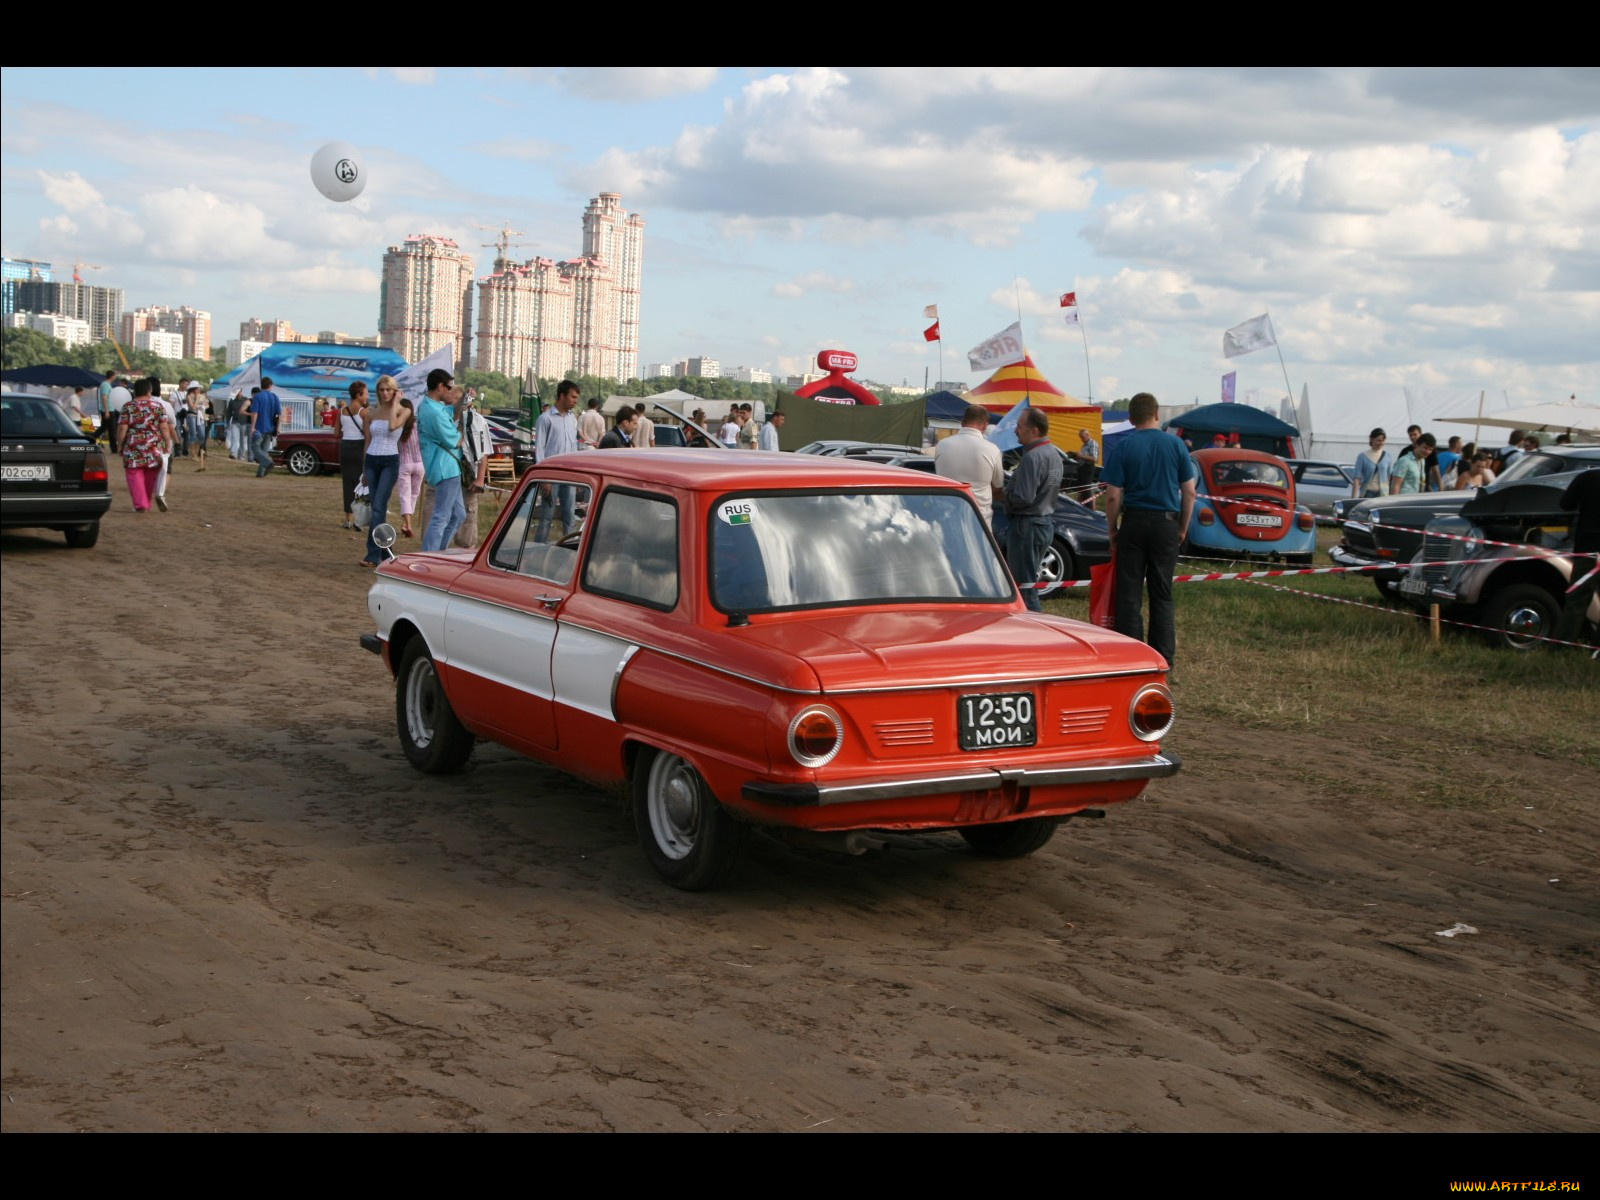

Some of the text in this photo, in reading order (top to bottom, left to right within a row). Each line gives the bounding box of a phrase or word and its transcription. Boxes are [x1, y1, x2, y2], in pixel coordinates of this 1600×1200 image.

[304, 357, 368, 369] БАЛТИКА
[724, 504, 752, 515] RUS
[975, 726, 1022, 745] МОИ
